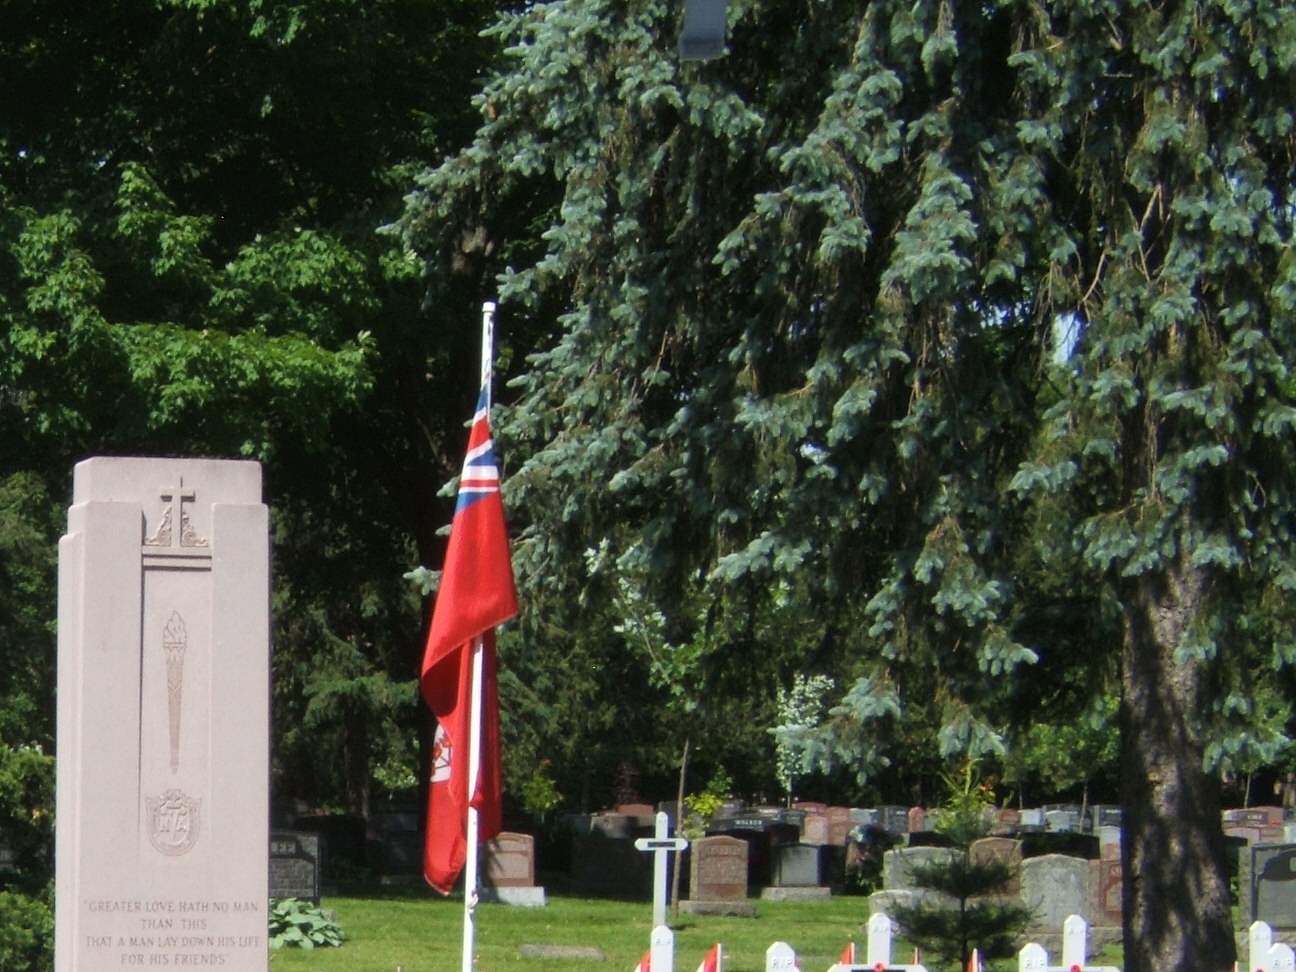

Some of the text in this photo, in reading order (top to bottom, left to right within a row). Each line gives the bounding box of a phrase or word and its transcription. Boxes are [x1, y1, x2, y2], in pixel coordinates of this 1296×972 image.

[145, 901, 175, 913] LOVE
[179, 901, 209, 913] HATH
[213, 902, 230, 914] NO
[233, 902, 260, 913] MAN
[141, 918, 207, 930] THAN THIS
[86, 936, 261, 948] THAT A MAN LAY DOWN HIS LIFE
[121, 954, 144, 966] FOR
[149, 954, 169, 966] HIS
